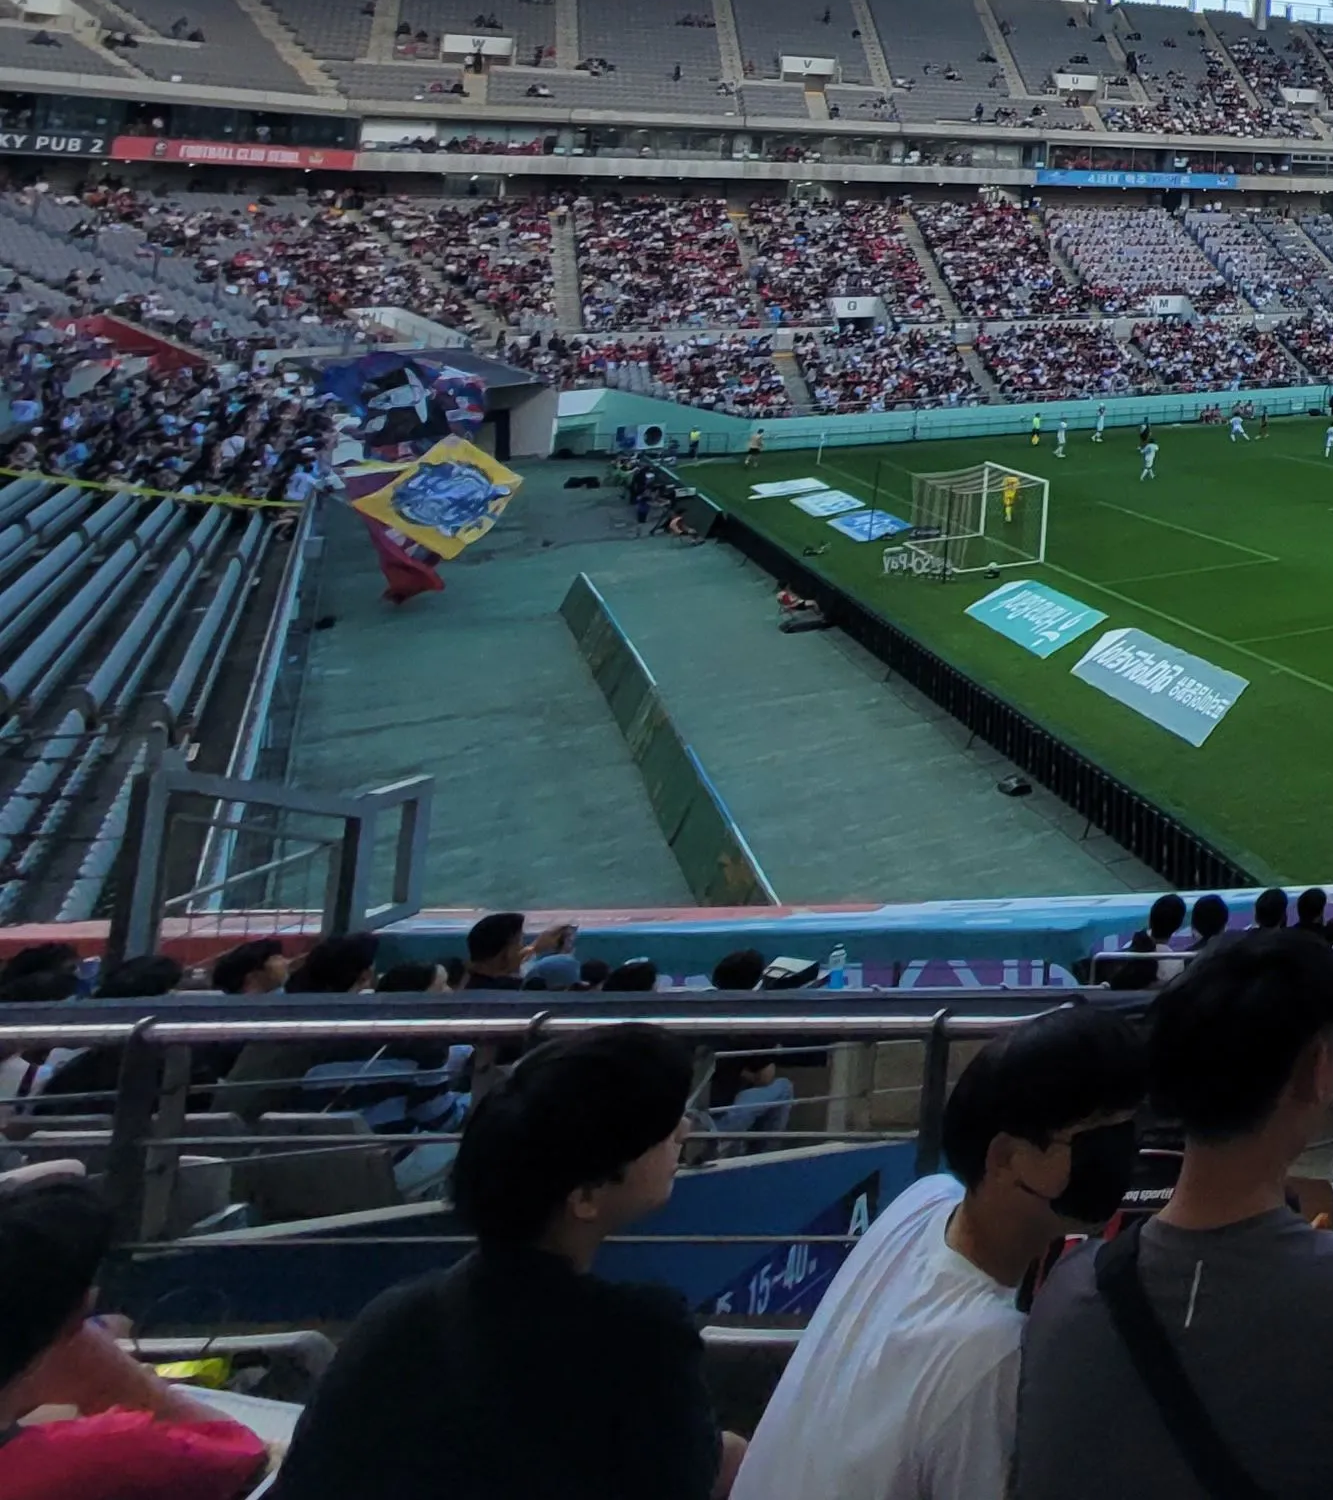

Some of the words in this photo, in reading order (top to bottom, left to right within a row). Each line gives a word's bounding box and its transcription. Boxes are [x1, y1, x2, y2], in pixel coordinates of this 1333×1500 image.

[472, 38, 486, 49] W
[35, 136, 82, 152] PUB
[89, 139, 104, 153] 2
[1139, 1188, 1175, 1201] sportif
